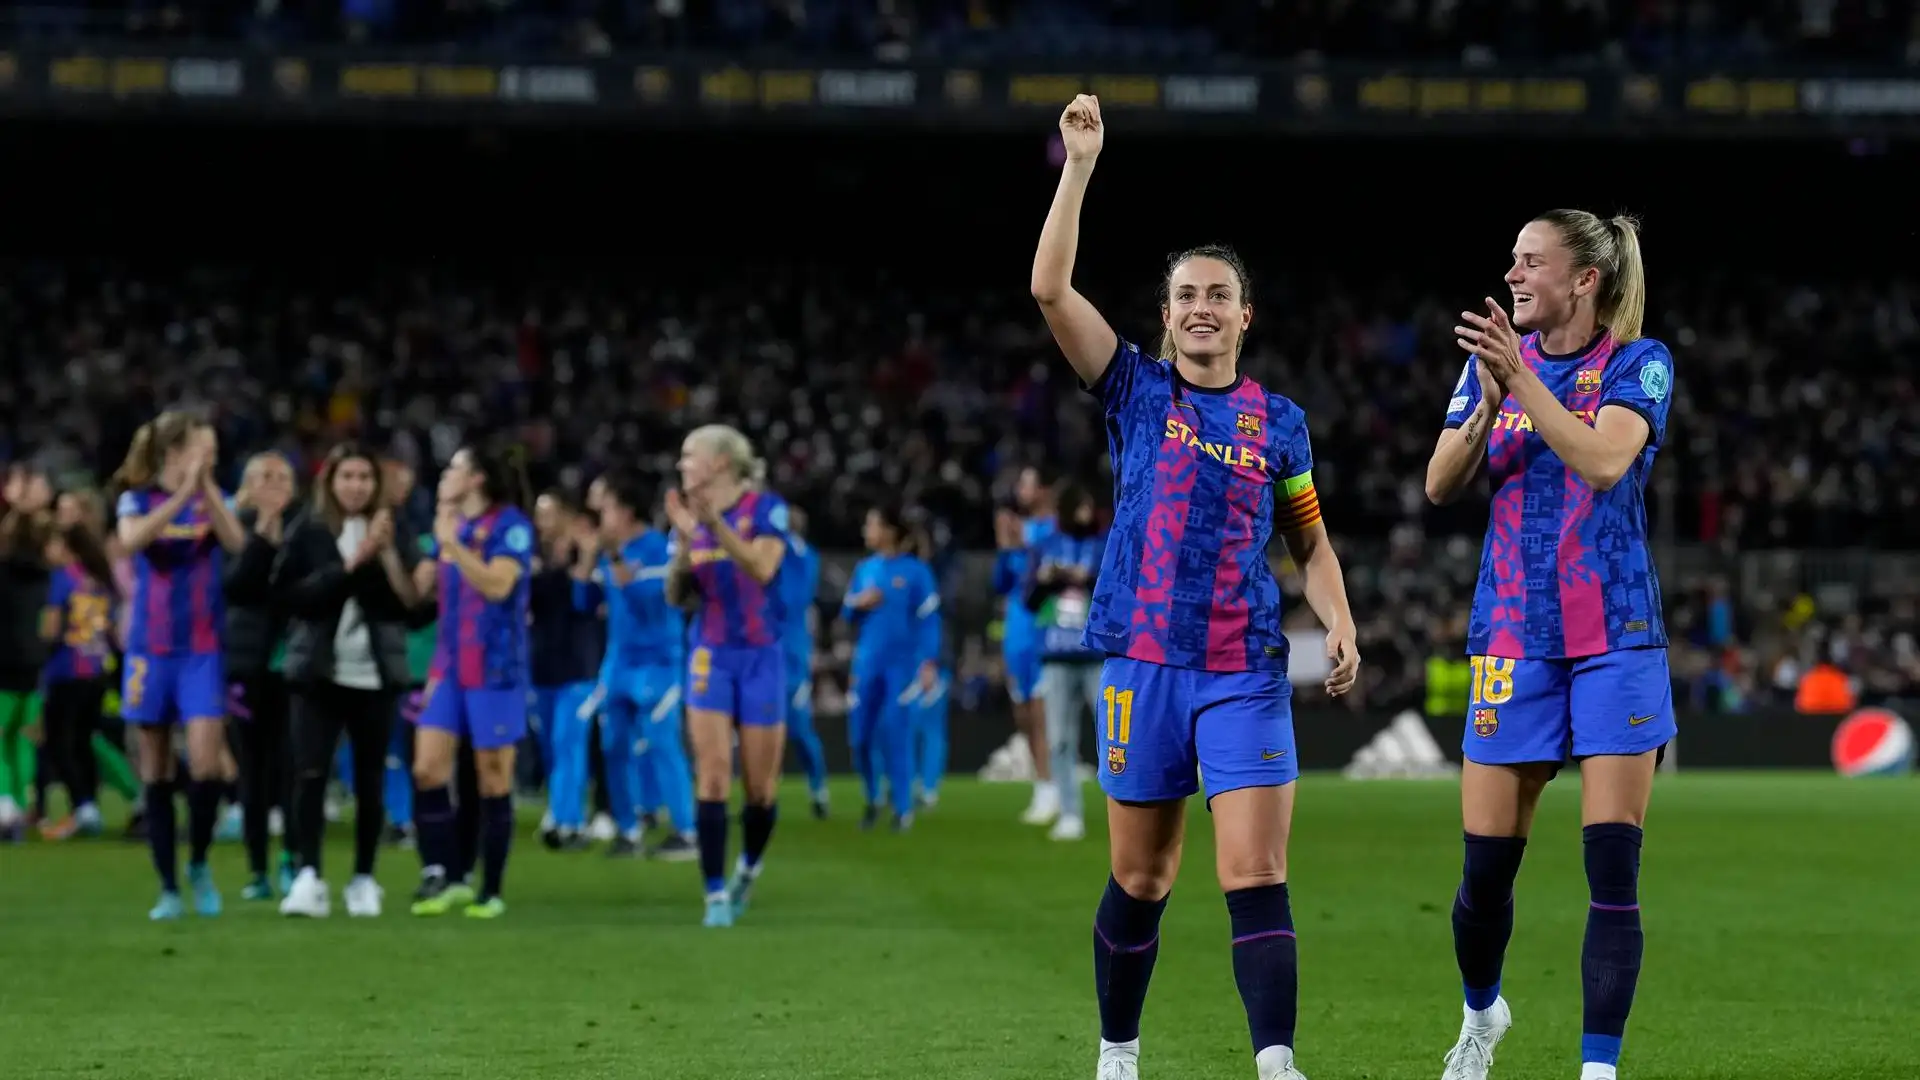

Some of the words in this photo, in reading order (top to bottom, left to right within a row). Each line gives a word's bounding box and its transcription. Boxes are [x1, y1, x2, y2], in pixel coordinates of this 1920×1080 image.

[1164, 419, 1267, 472] STANLEY
[1470, 655, 1516, 705] 18
[1103, 685, 1134, 745] 11
